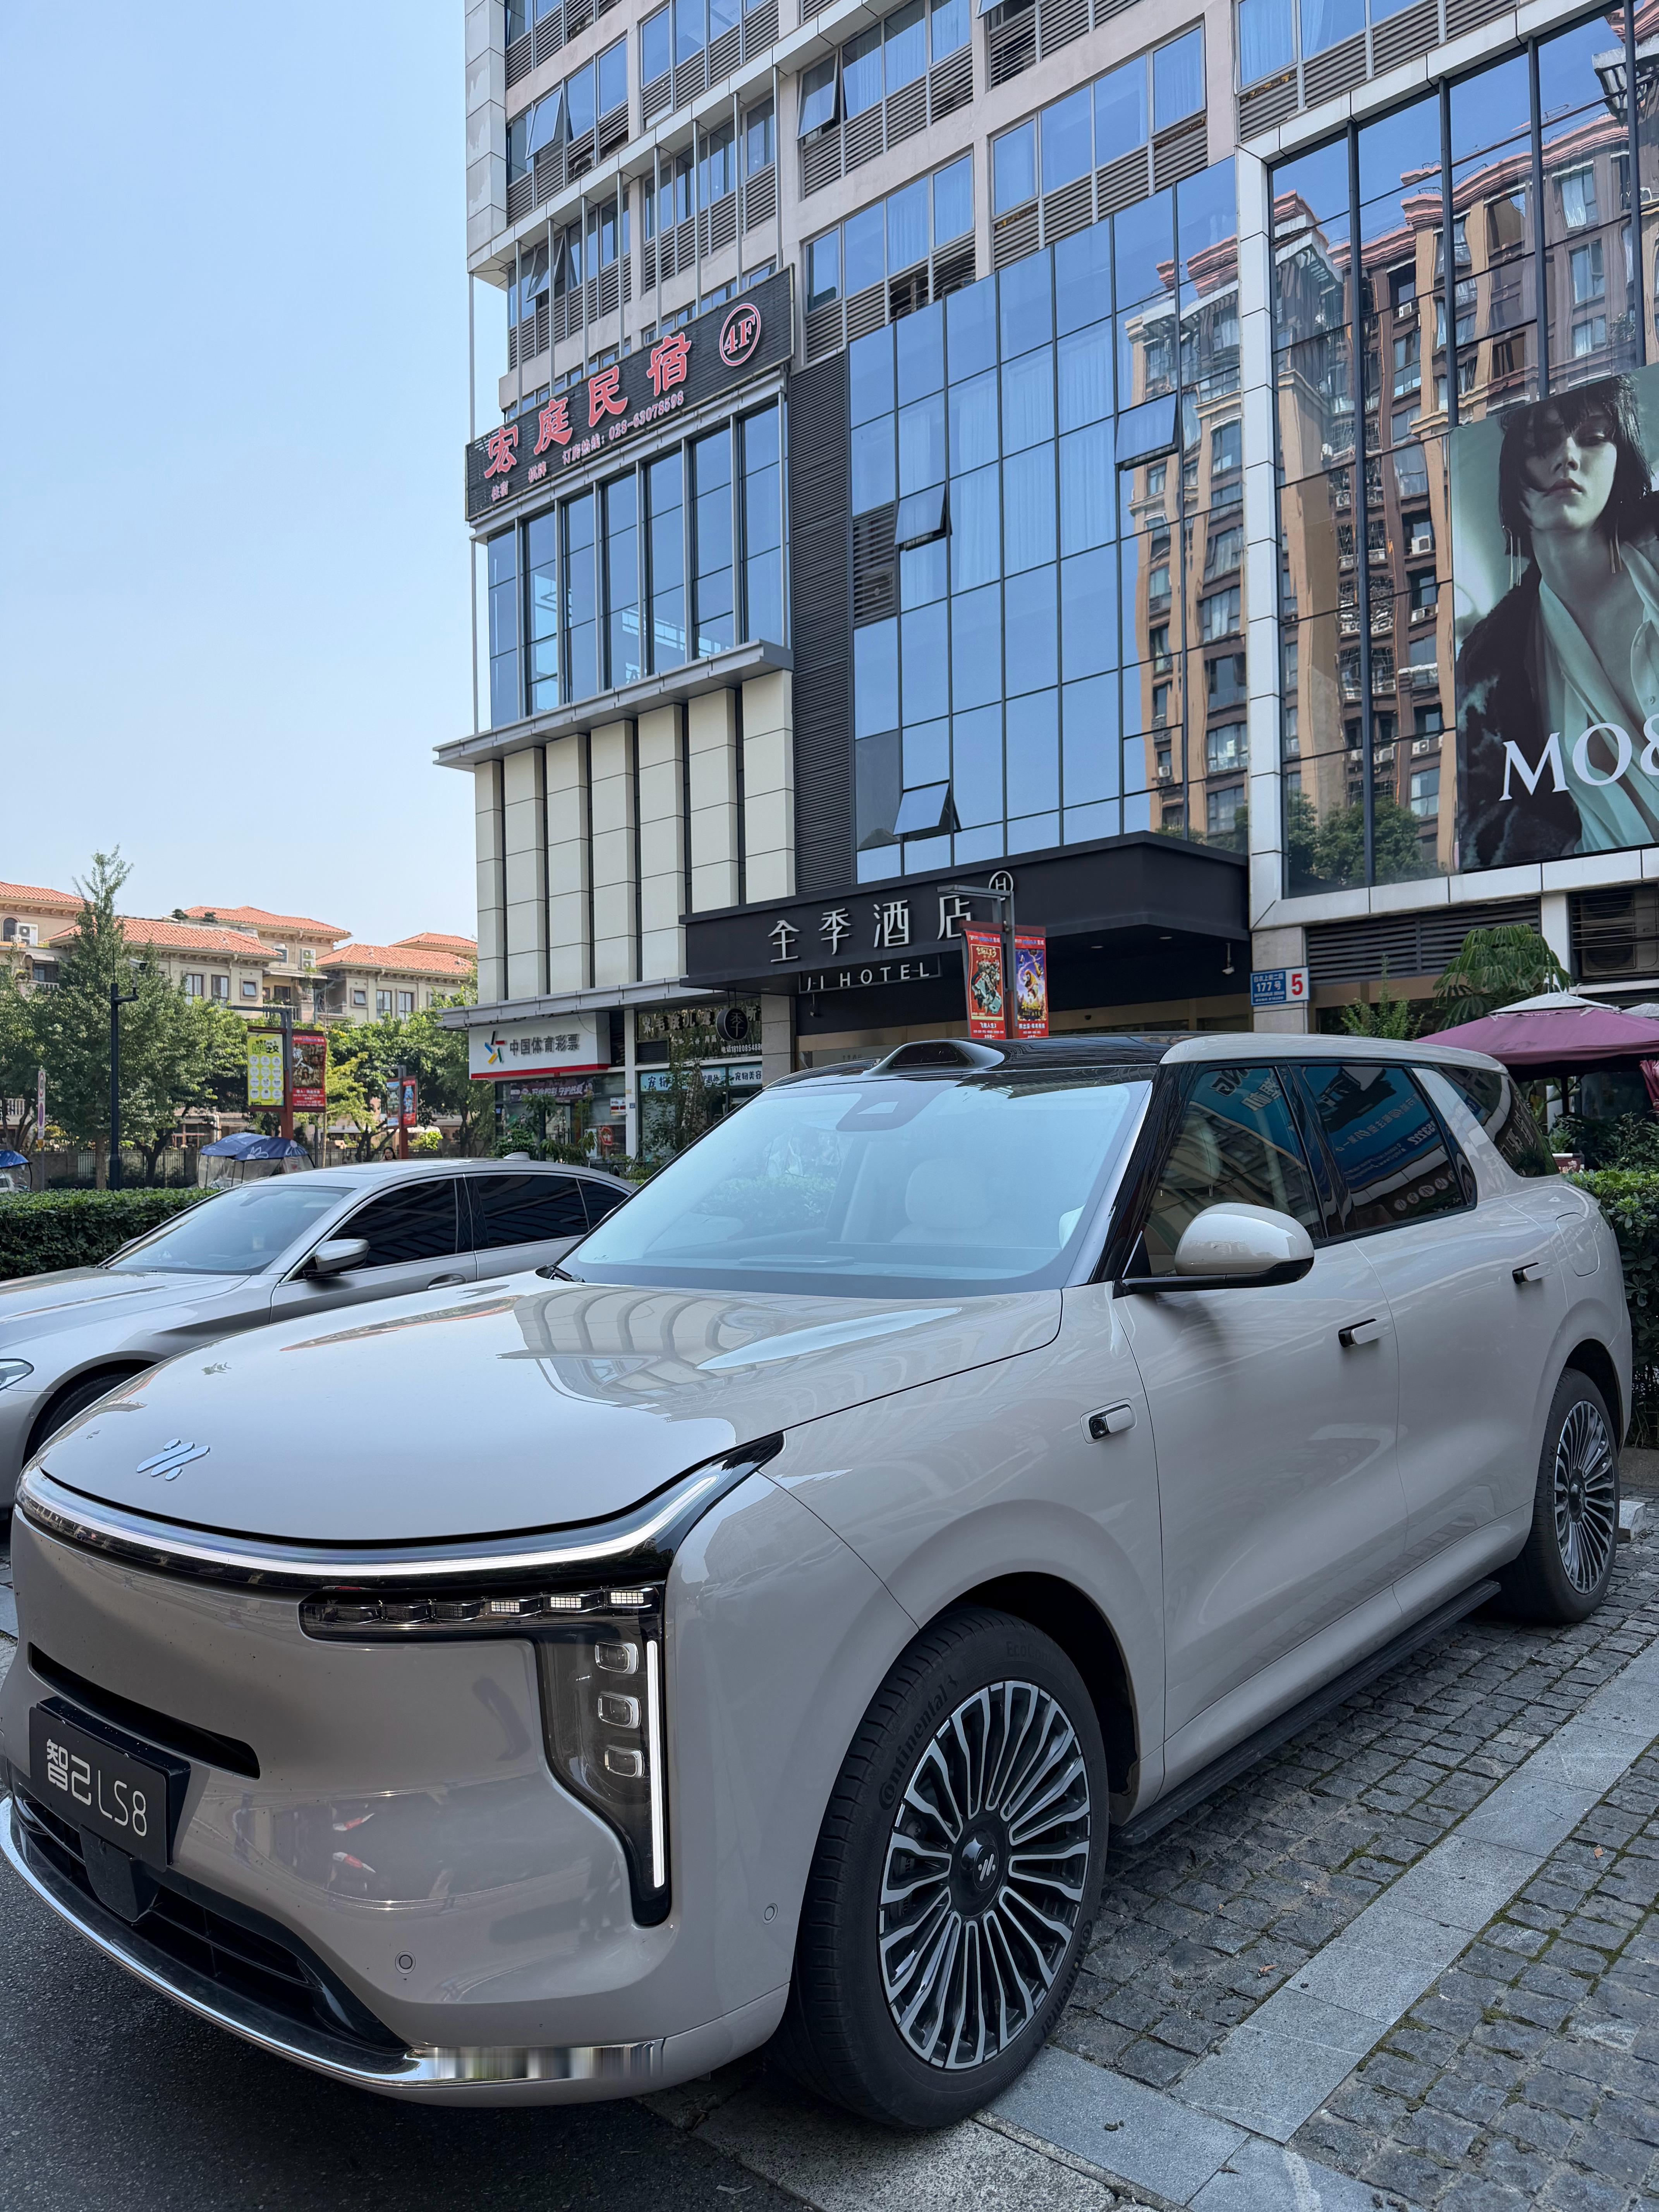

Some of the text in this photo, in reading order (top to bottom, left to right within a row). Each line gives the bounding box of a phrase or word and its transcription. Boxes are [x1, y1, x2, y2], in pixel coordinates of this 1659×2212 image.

[723, 315, 756, 355] 4F
[484, 332, 692, 479] 宏庭民宿
[768, 895, 971, 963] 全季酒店
[807, 962, 929, 991] JI HOTEL
[1291, 973, 1303, 996] 5
[730, 1012, 744, 1037] 季
[509, 1032, 580, 1056] 中国体育彩票
[735, 1070, 762, 1081] 宠物美容
[878, 1688, 949, 1811] Continental
[97, 1769, 147, 1836] LS8
